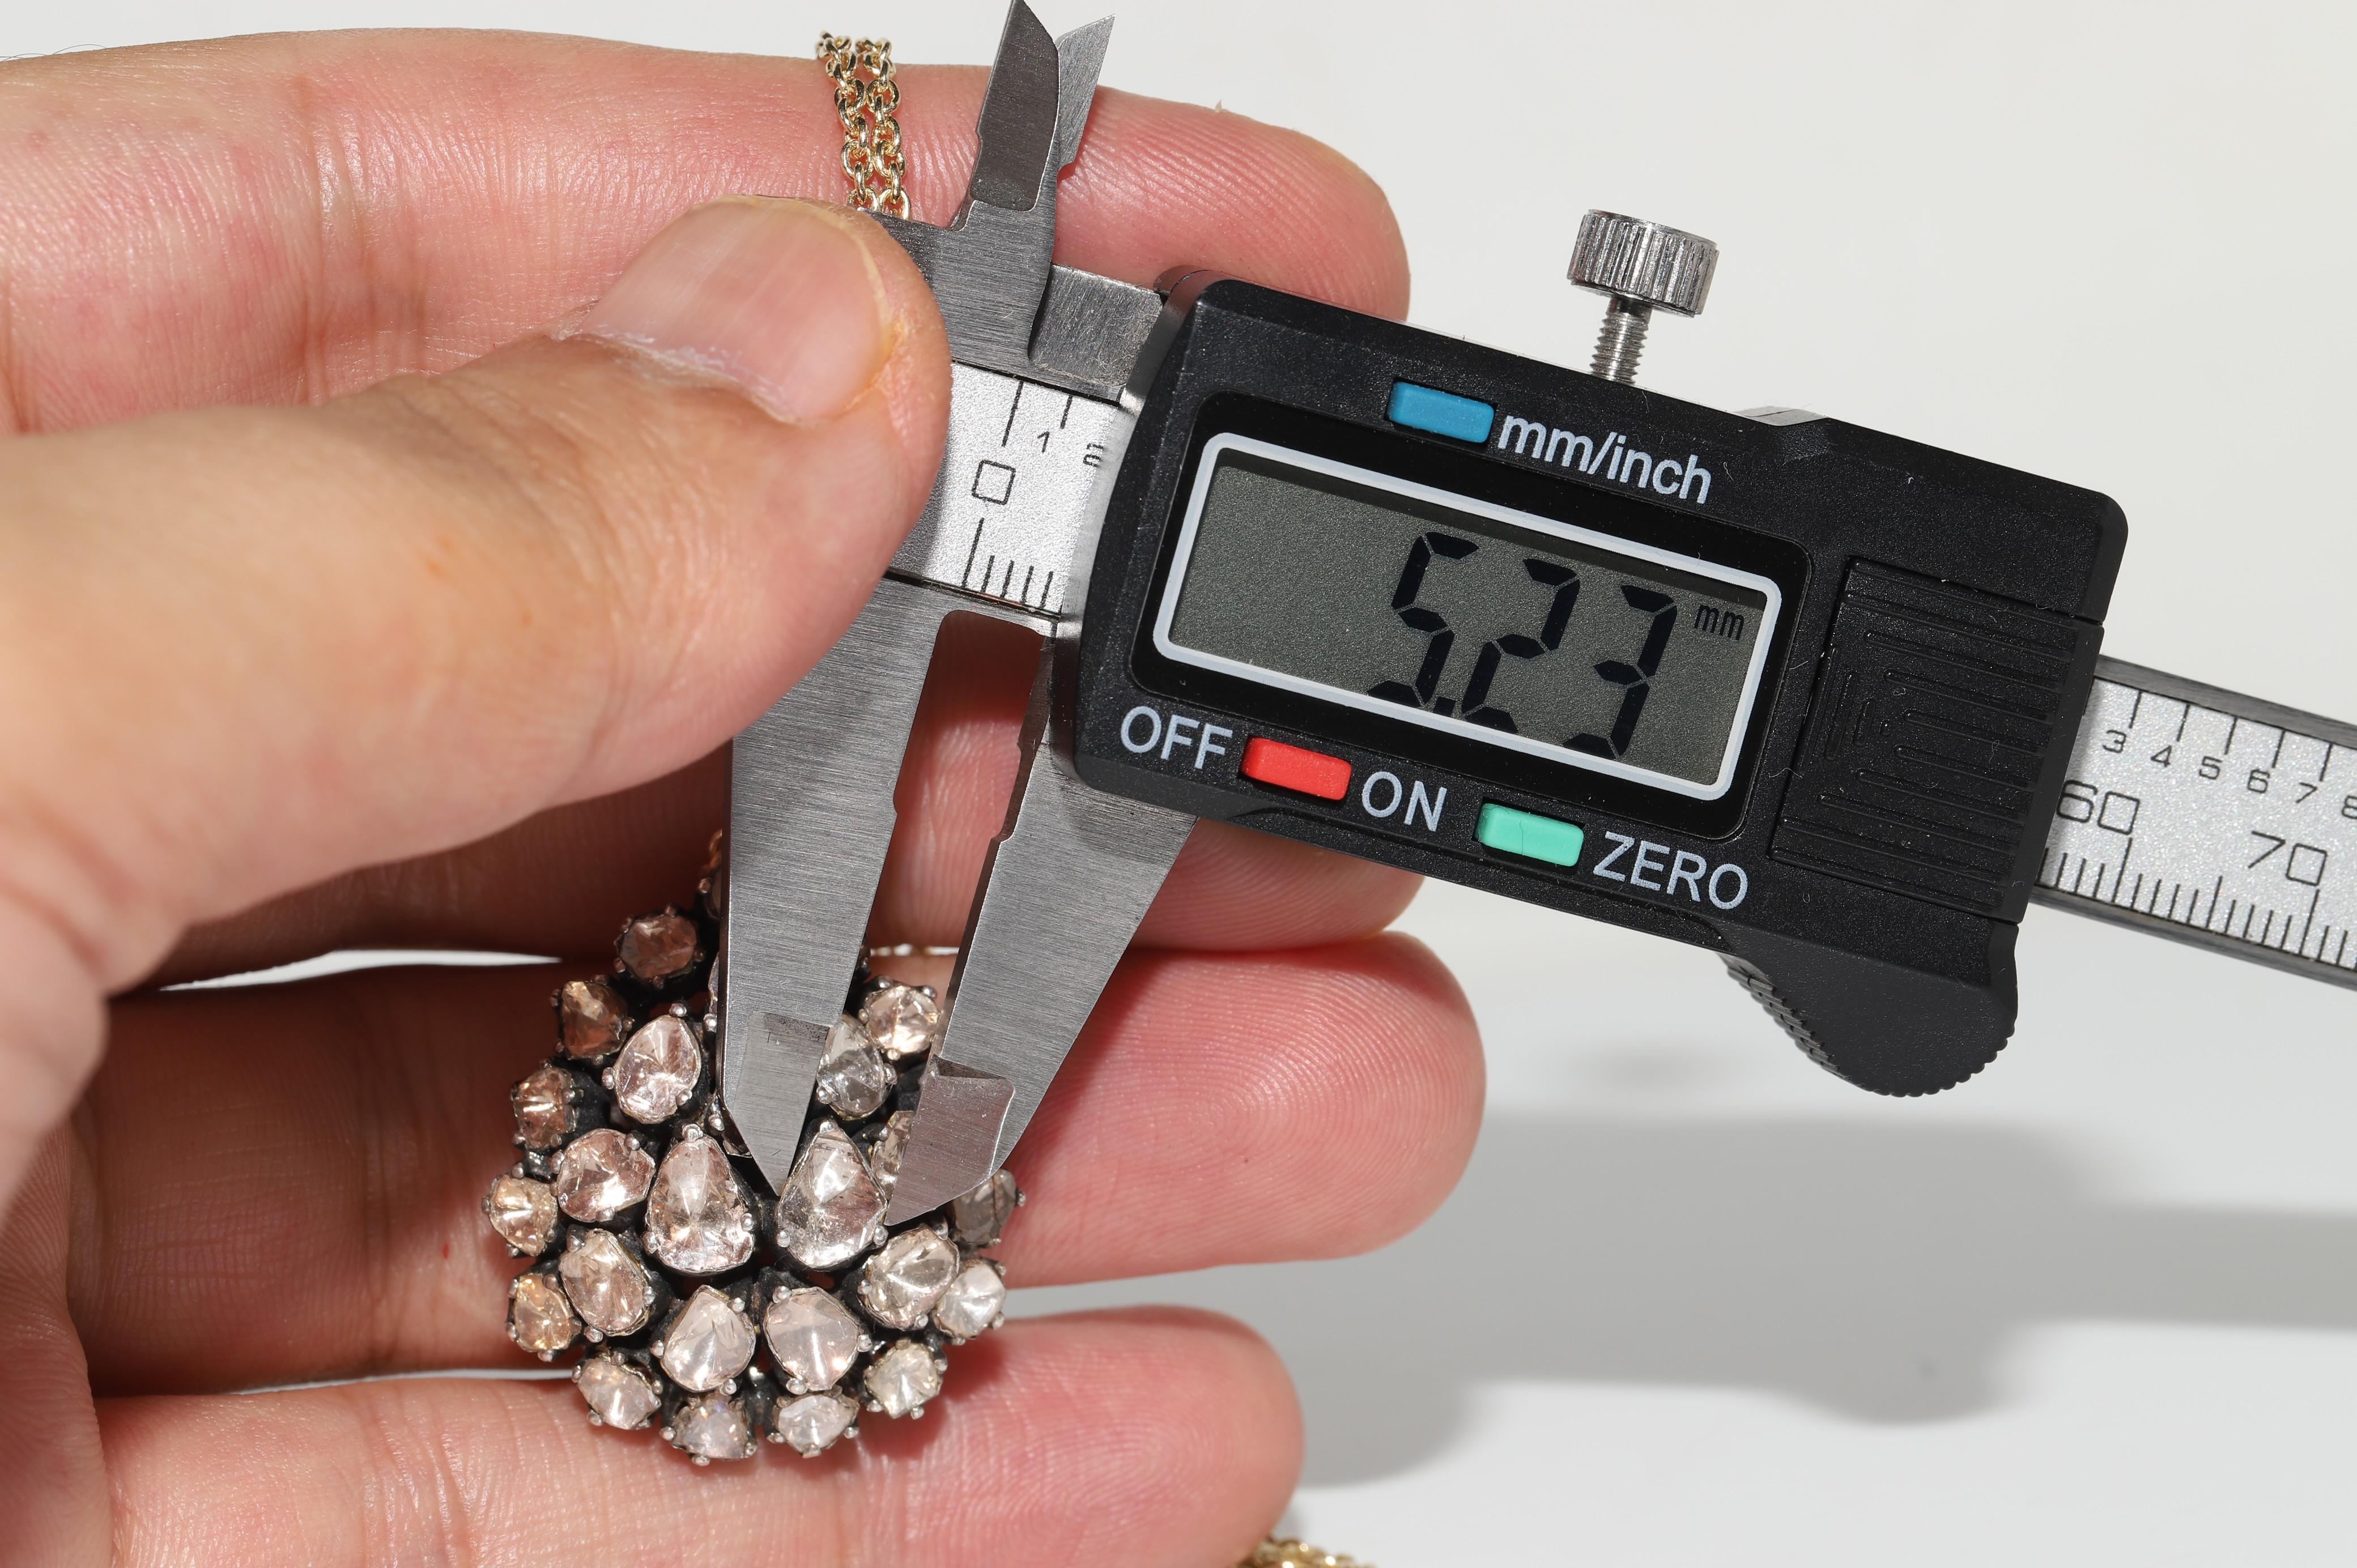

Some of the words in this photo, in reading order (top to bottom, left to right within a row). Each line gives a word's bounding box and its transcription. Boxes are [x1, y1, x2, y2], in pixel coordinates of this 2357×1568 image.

[1037, 431, 1050, 453] 1
[1497, 415, 1712, 504] mm/inch
[971, 459, 1016, 505] 0
[1367, 531, 1677, 759] 5.23
[1694, 604, 1745, 641] mm
[1120, 706, 1233, 769] OFF
[2103, 730, 2126, 753] 3
[2150, 745, 2172, 768] 4
[2198, 756, 2222, 780] 5
[2247, 769, 2270, 794] 6
[2296, 782, 2317, 803] 7
[2342, 795, 2357, 819] 8
[1362, 771, 1447, 832] ON
[2057, 779, 2140, 835] 60
[2248, 831, 2328, 886] 70
[1593, 831, 1748, 909] ZERO
